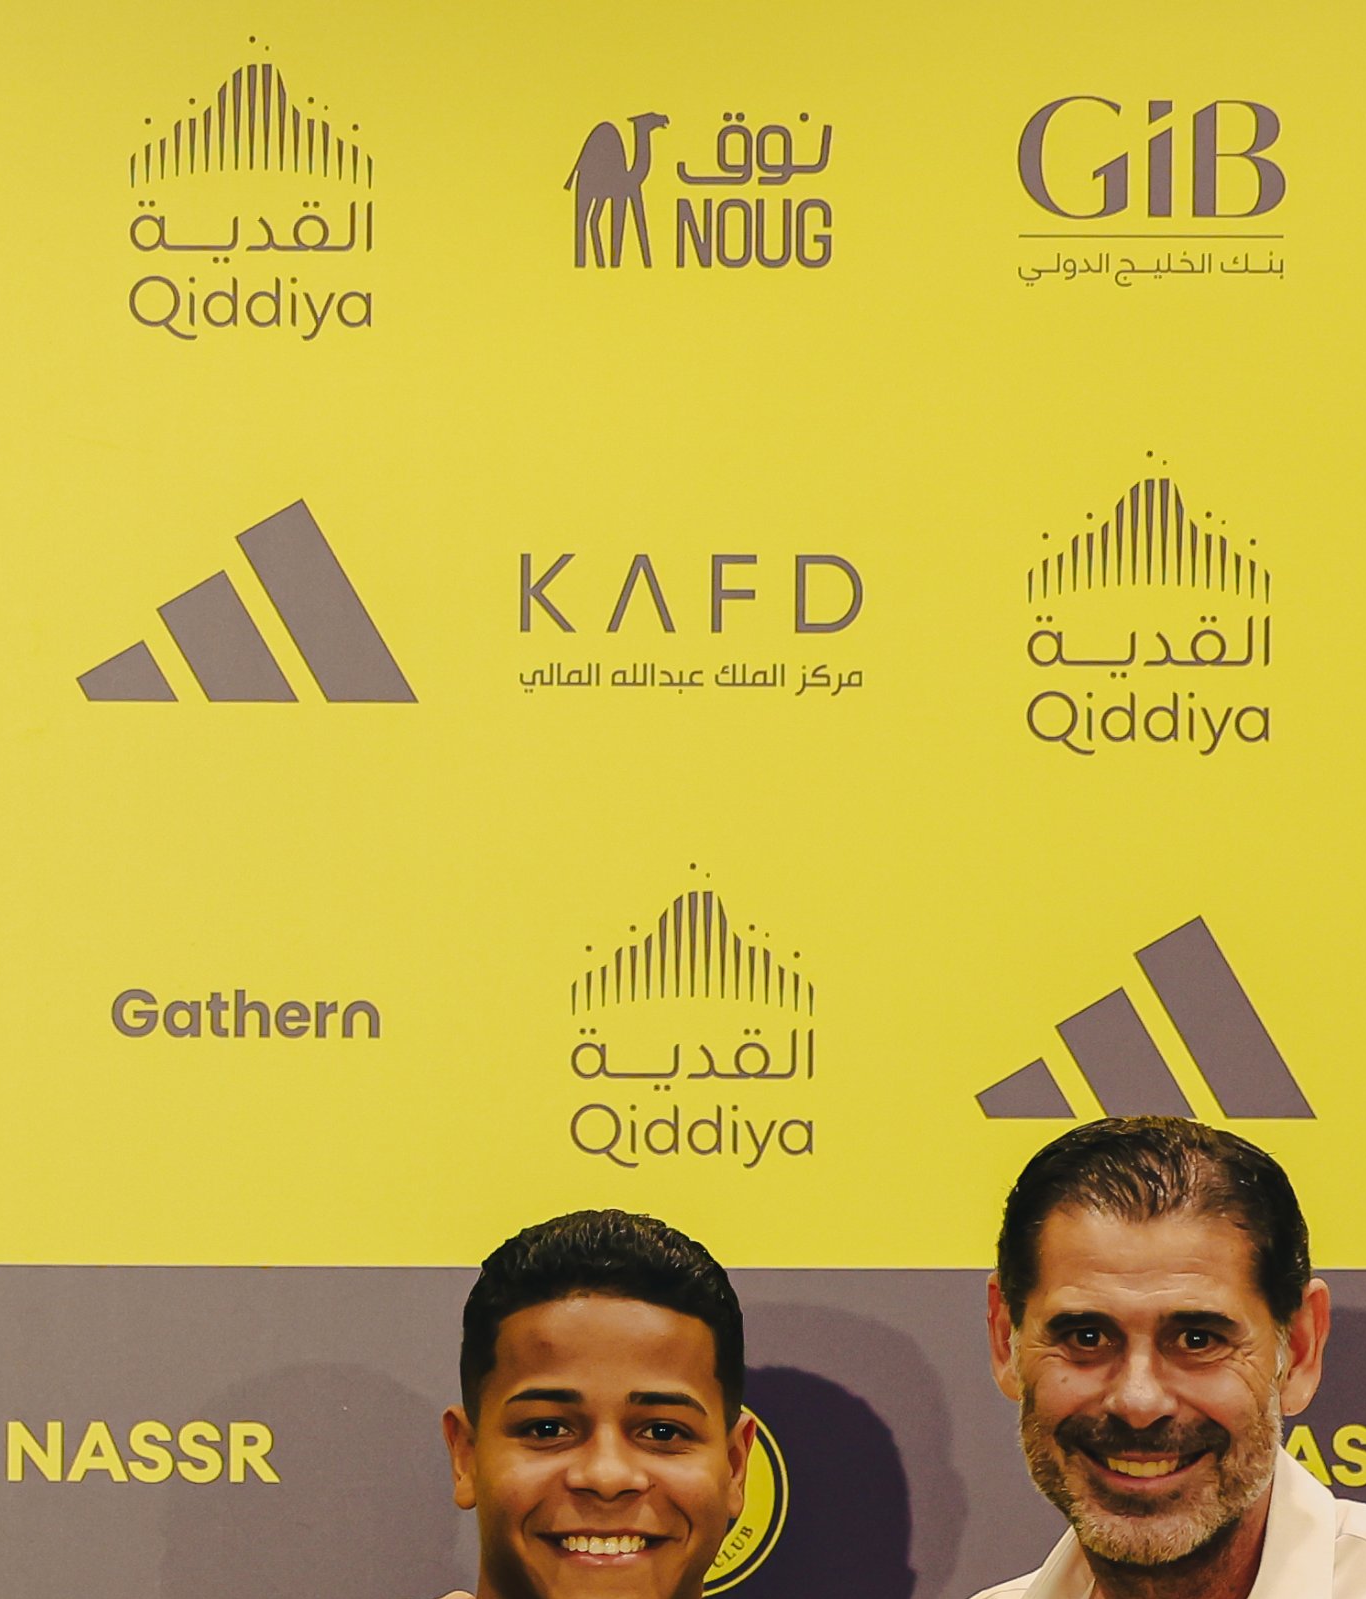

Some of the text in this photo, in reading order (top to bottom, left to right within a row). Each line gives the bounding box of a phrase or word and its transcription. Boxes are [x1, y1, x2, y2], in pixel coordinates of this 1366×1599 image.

[676, 111, 833, 186] نوق
[675, 197, 833, 269] NOUG
[128, 275, 372, 342] Qiddiya
[519, 553, 864, 634] KAFD
[519, 662, 863, 697] مركز الملك عبدالله المالي
[1026, 690, 1270, 756] Qiddiya
[111, 988, 381, 1039] Gathern
[569, 1103, 814, 1169] Qiddiya
[7, 1420, 280, 1483] NASSR
[713, 1525, 754, 1568] CLUB
